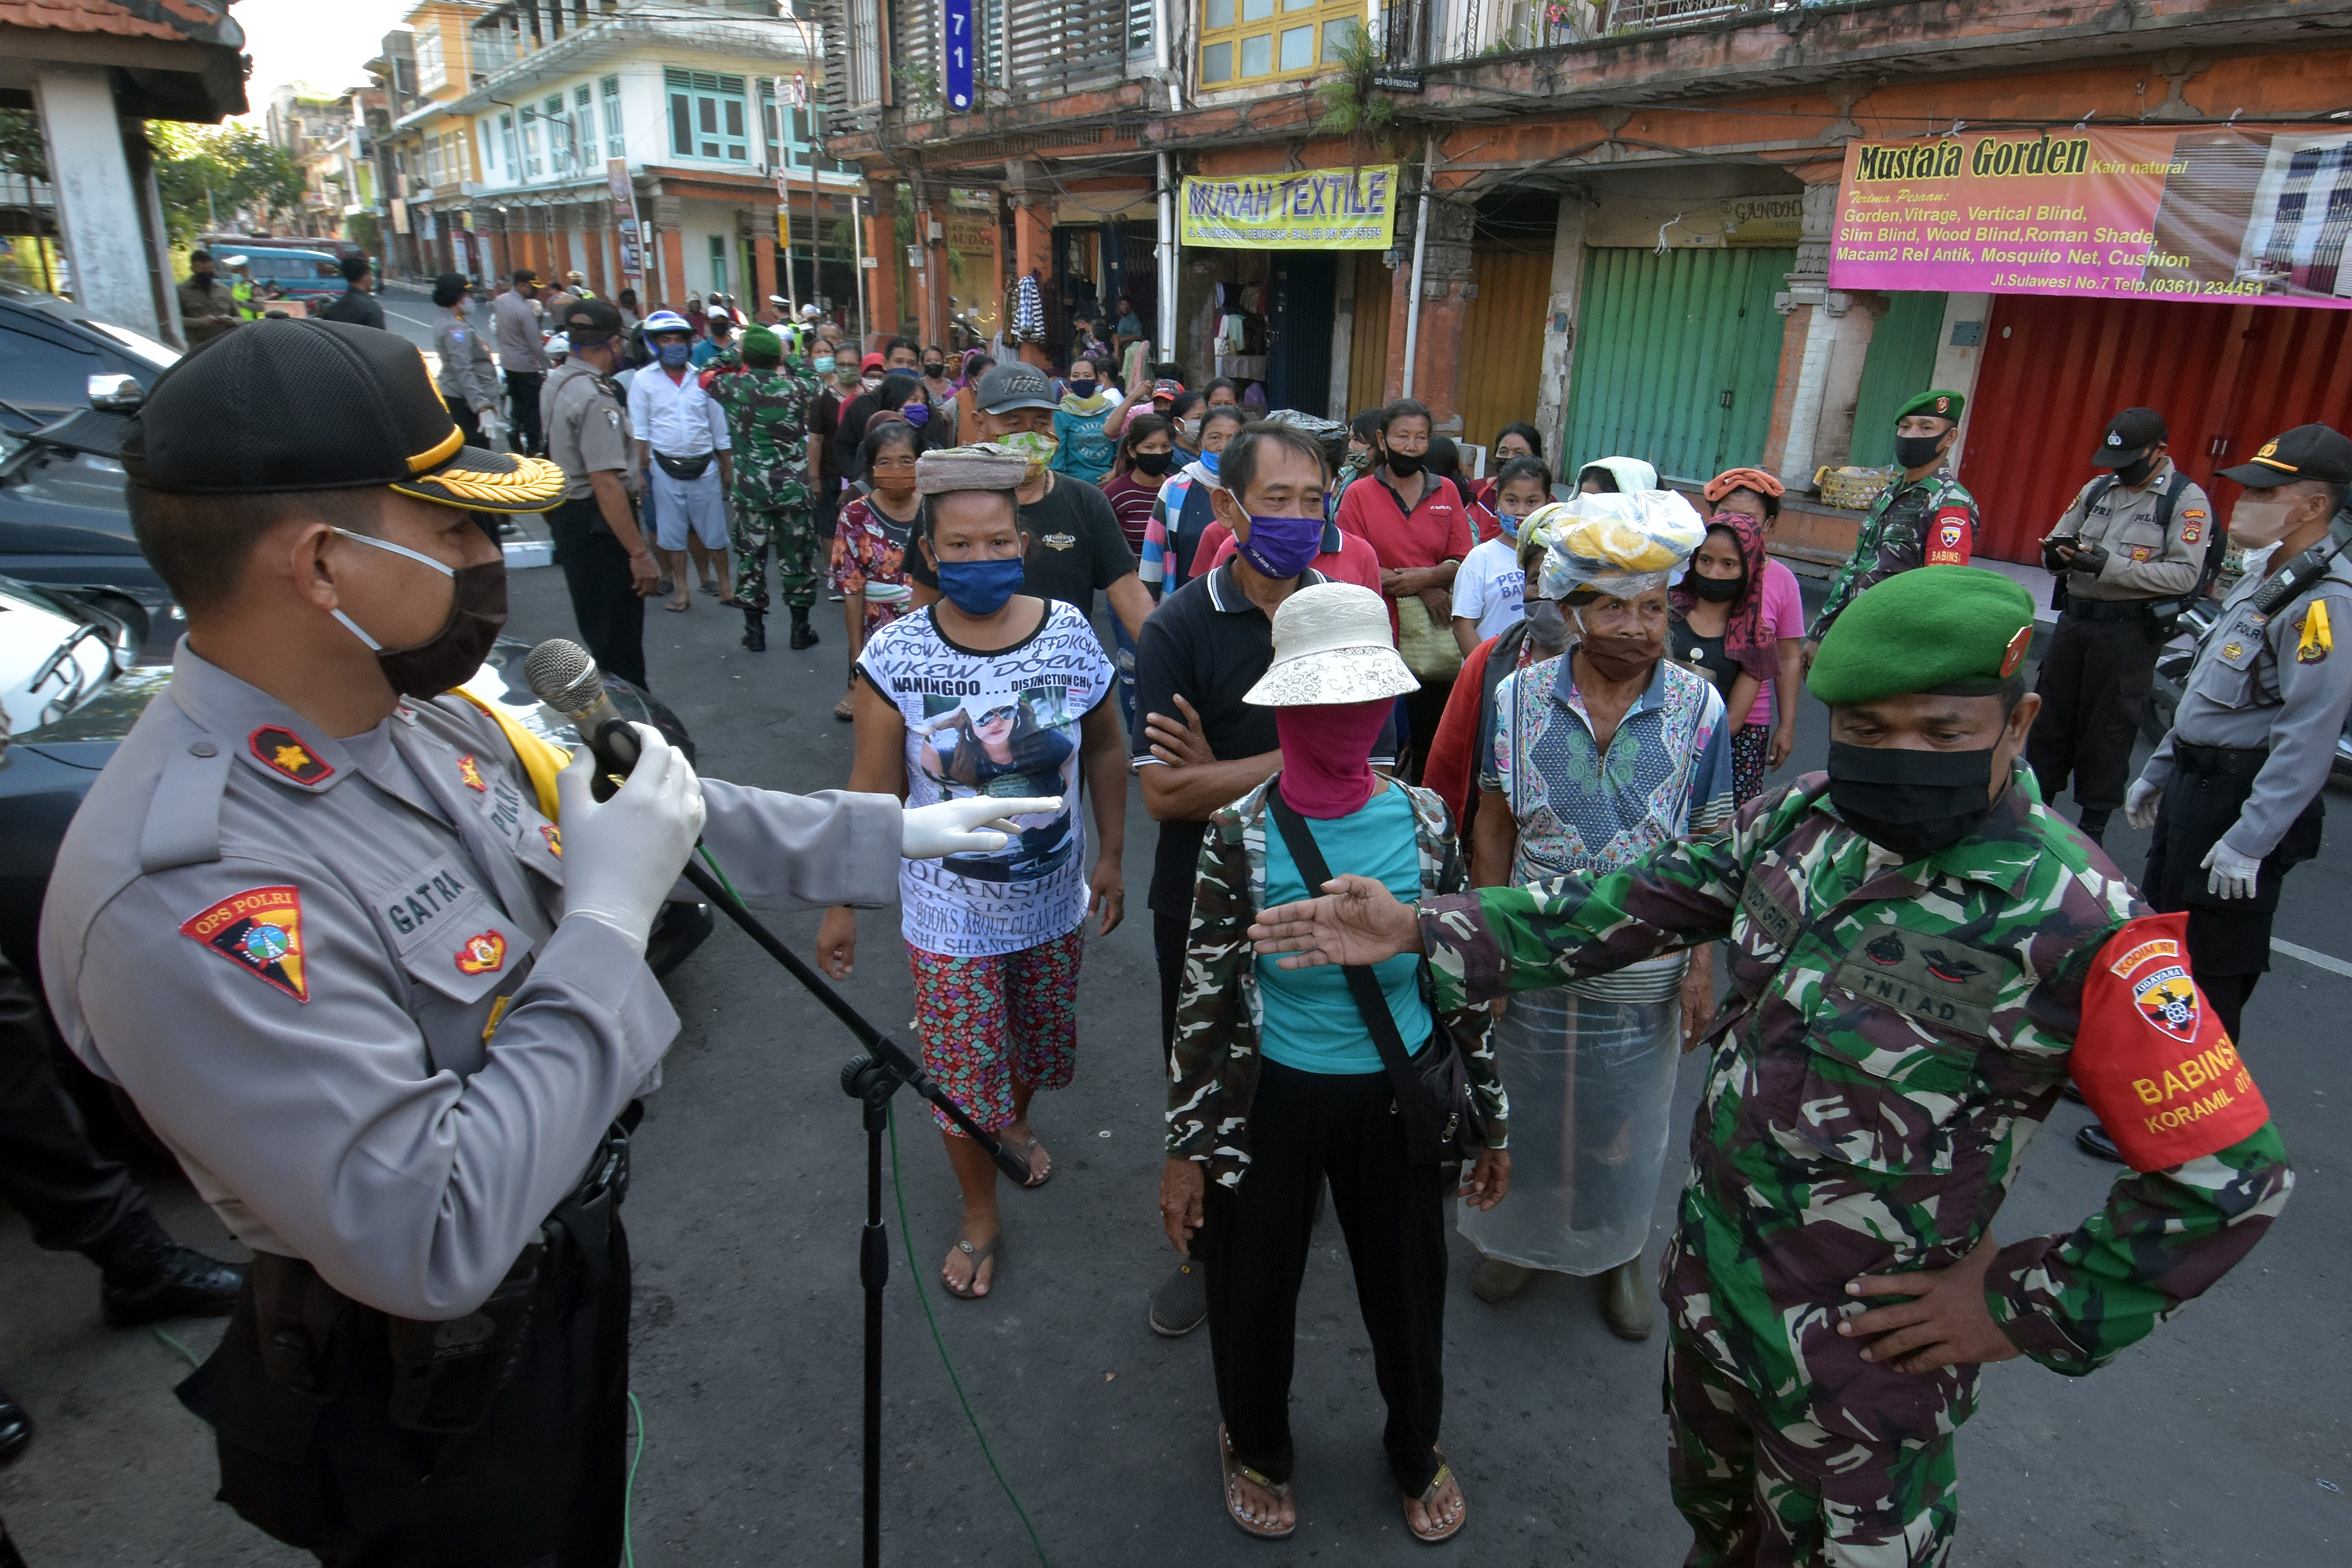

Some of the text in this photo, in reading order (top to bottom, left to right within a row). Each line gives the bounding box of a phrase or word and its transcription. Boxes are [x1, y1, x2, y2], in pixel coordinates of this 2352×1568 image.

[1855, 135, 2189, 182] Mustafa Gorden Kain natural
[1188, 172, 1388, 218] MURAH TEXTILE
[1849, 189, 1949, 204] Terima Pesaan:
[1968, 206, 2032, 221] Vertical
[2036, 206, 2087, 223] Blind,
[1248, 229, 1287, 240] DENPASAR
[1840, 228, 1873, 242] Slim
[1877, 228, 1920, 243] Blind,
[1926, 227, 1971, 241] Wood
[2094, 227, 2159, 246] Shade,
[1836, 247, 2191, 268] Macam2 Rel Antik, Mosquito Net, Cushion
[2074, 276, 2110, 290] No.7
[2203, 281, 2264, 296] 234451
[891, 677, 981, 697] NANINGOO
[1011, 673, 1072, 693] DISTINCTION
[490, 778, 519, 836] POLRI
[195, 891, 293, 935] OPS POLRI
[388, 868, 466, 935] GATRA
[916, 901, 958, 934] BOOKS
[962, 911, 1008, 935] ABOUT
[911, 928, 937, 950] SHI
[943, 937, 1015, 954] SHANG
[2116, 943, 2156, 975] KODIM
[2136, 967, 2184, 993] UDAYANA
[1862, 973, 1956, 1021] TNI AD
[2143, 1088, 2235, 1135] KORAMIL
